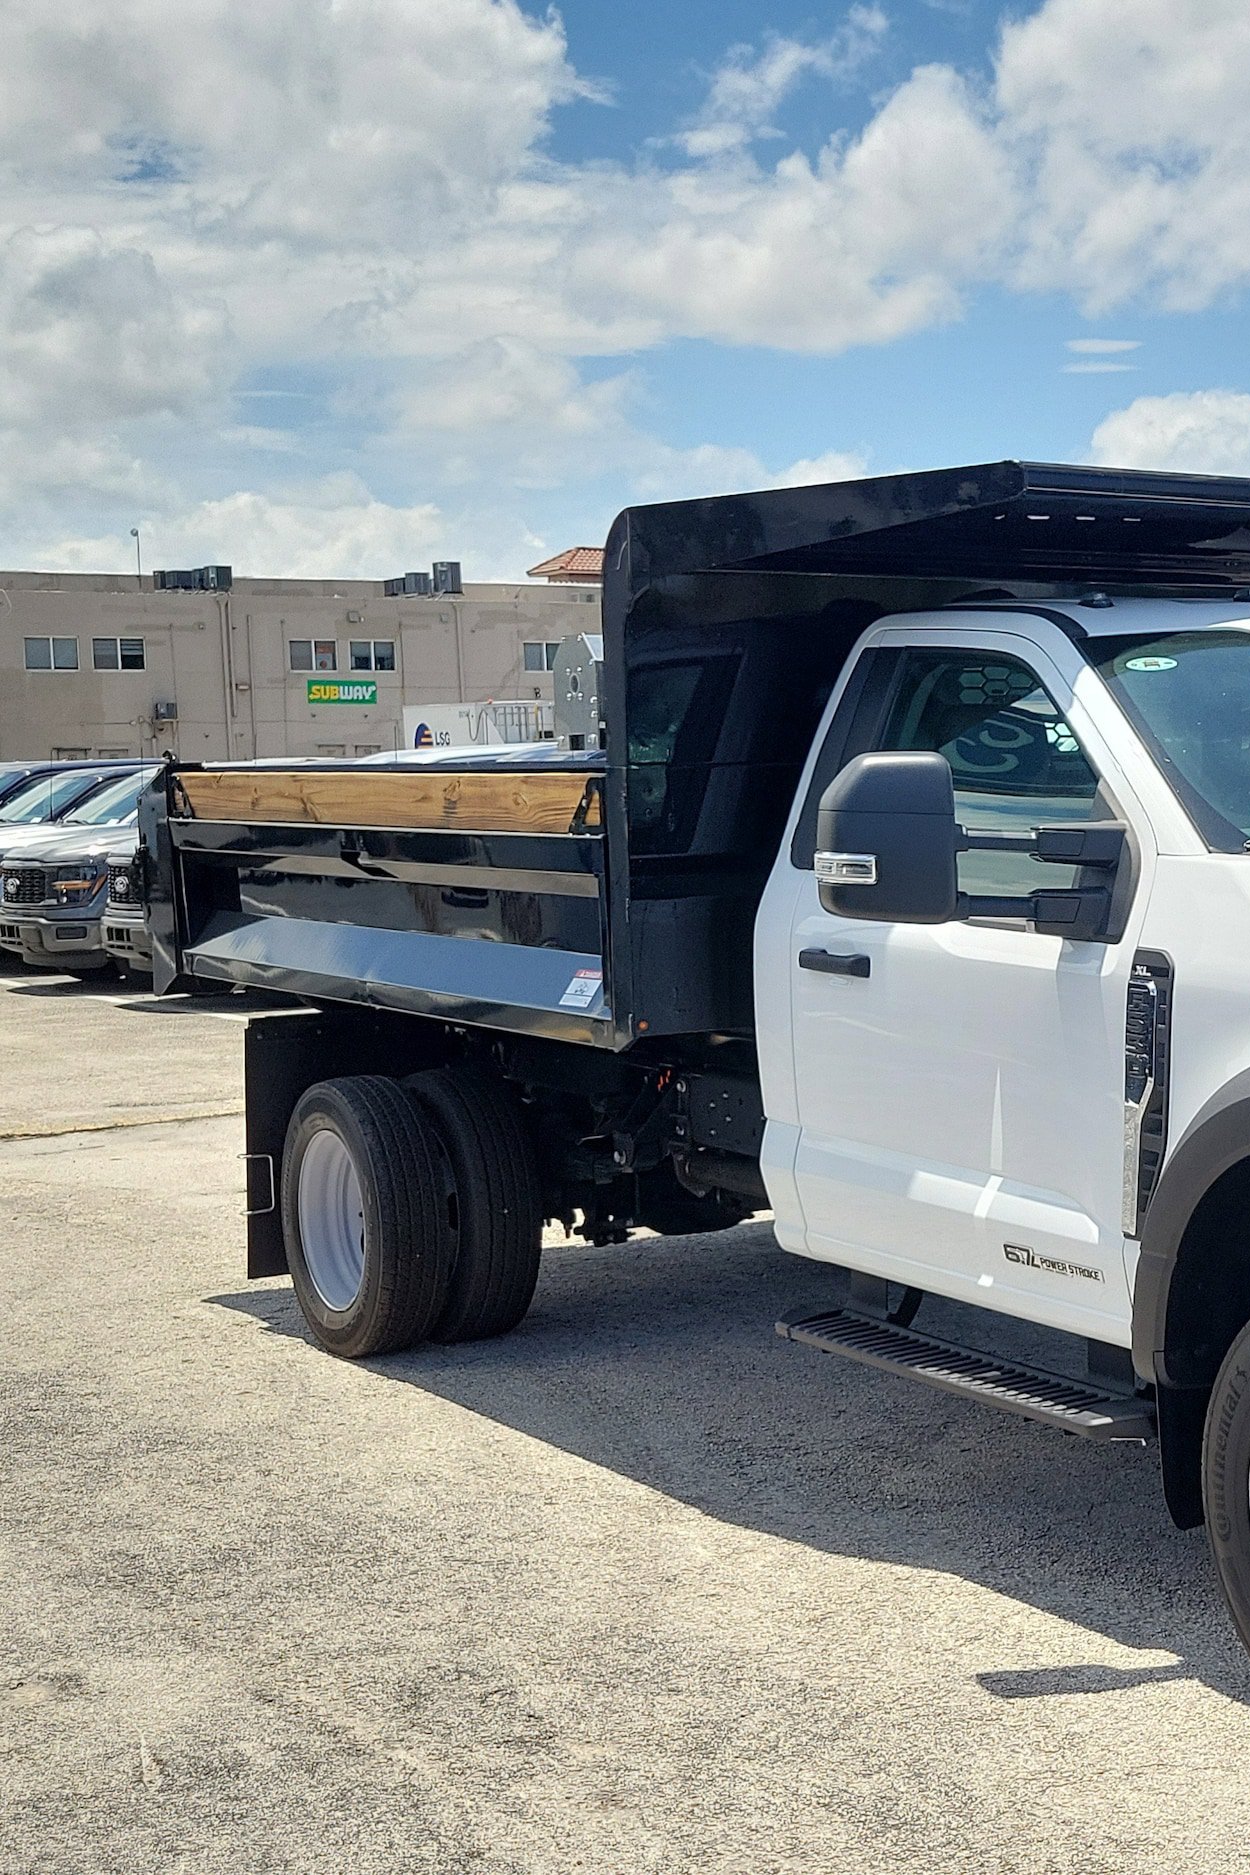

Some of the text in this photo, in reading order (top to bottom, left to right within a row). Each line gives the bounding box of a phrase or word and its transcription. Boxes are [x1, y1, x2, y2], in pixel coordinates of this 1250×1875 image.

[309, 685, 377, 701] SUBWAY
[434, 732, 451, 746] LSG
[1133, 964, 1152, 977] XL
[1003, 1243, 1041, 1269] 6.7L
[1040, 1257, 1068, 1273] POWER
[1068, 1264, 1101, 1281] STROKE
[1213, 1379, 1242, 1542] Continental
